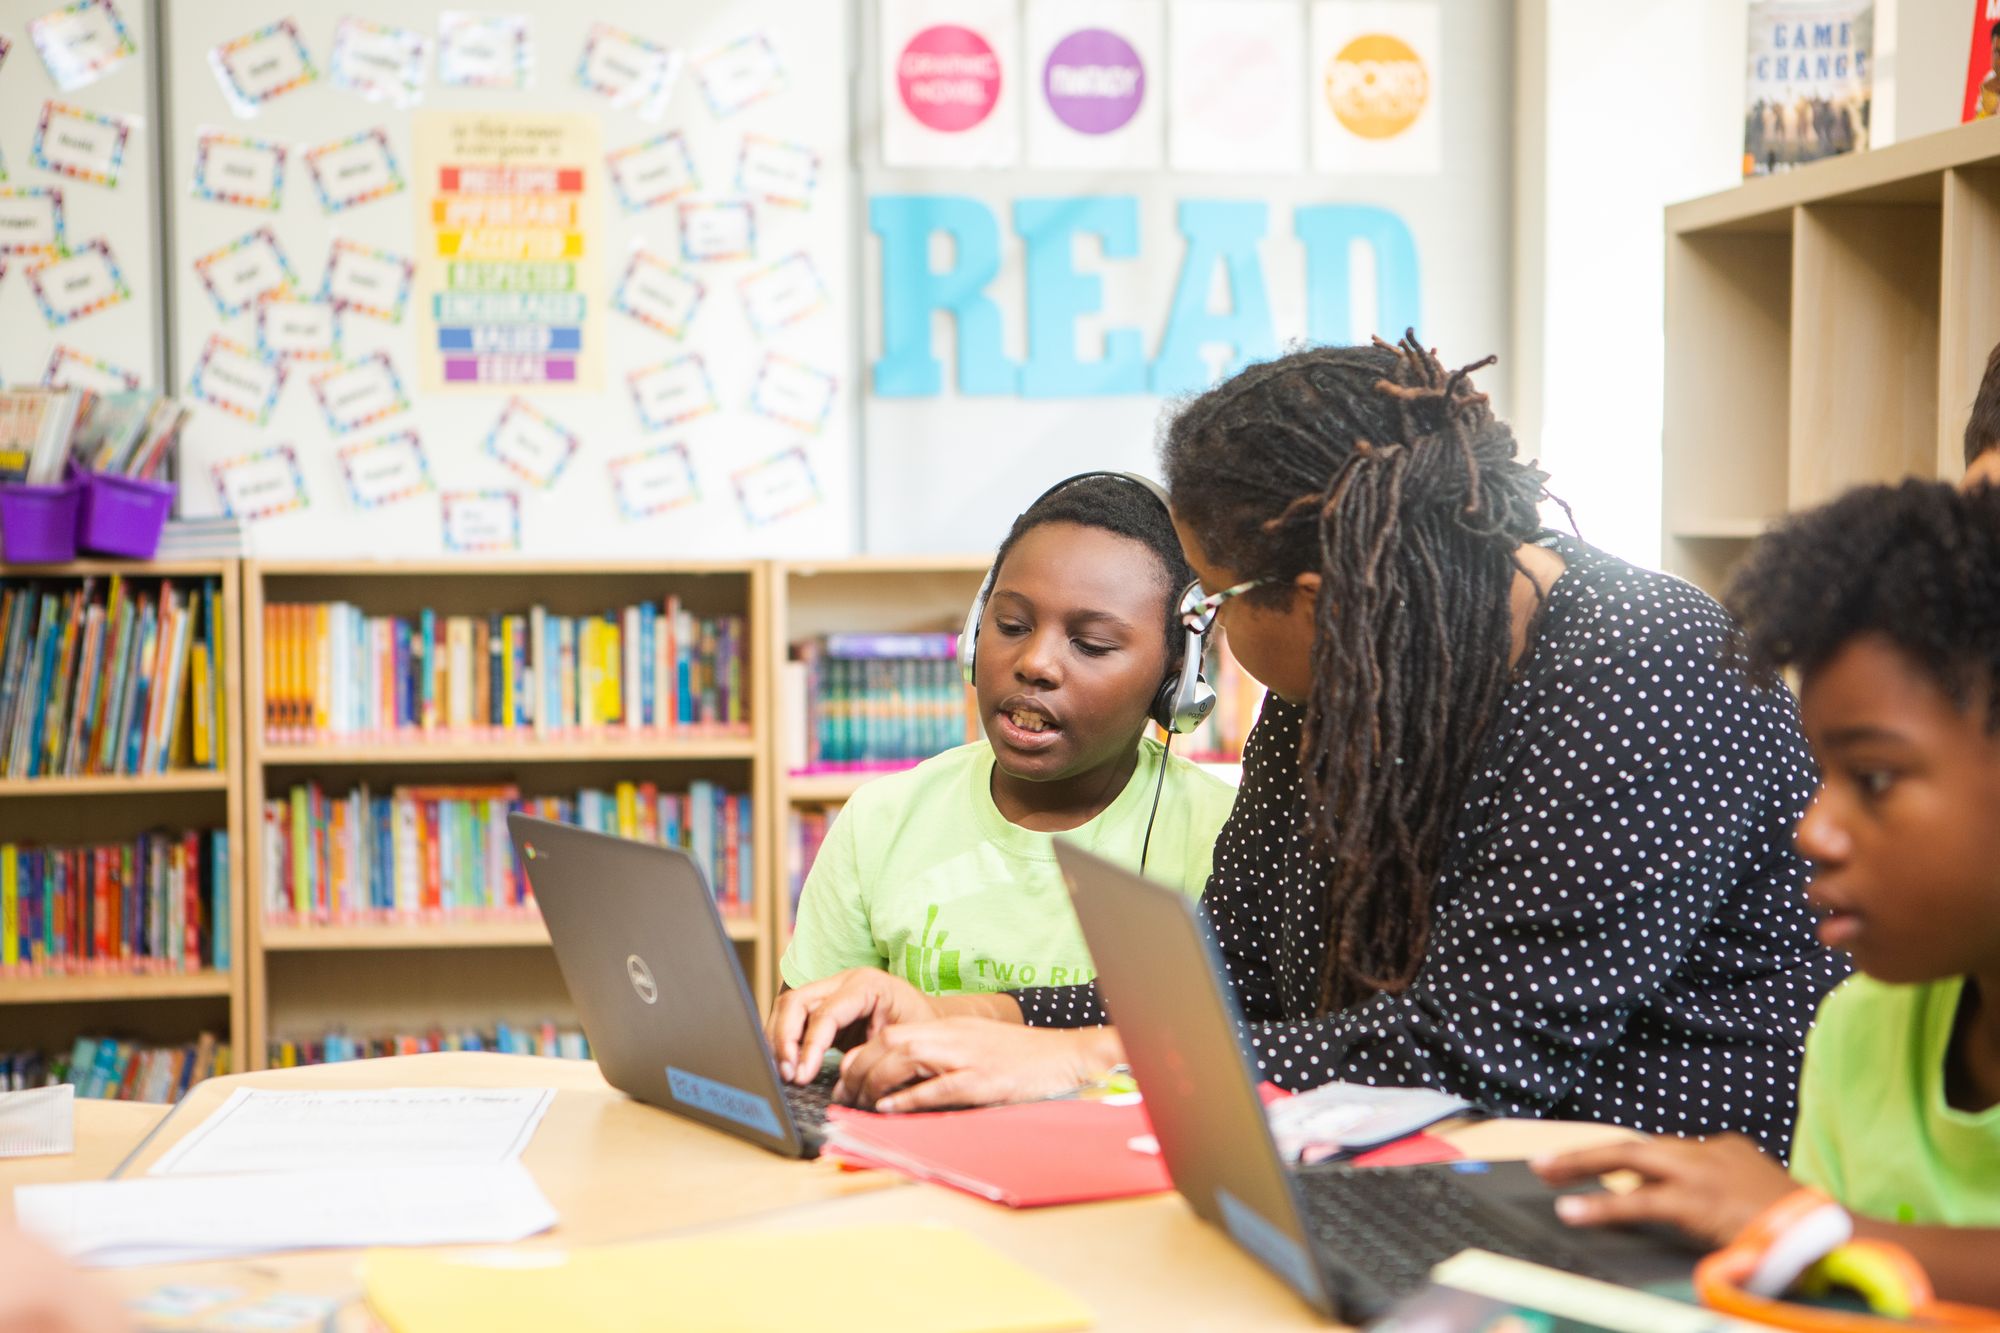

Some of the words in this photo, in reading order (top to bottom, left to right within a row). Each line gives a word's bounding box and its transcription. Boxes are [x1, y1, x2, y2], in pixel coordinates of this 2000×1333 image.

[1774, 22, 1850, 48] GAME
[869, 194, 1420, 397] READ
[974, 960, 1036, 985] TWO
